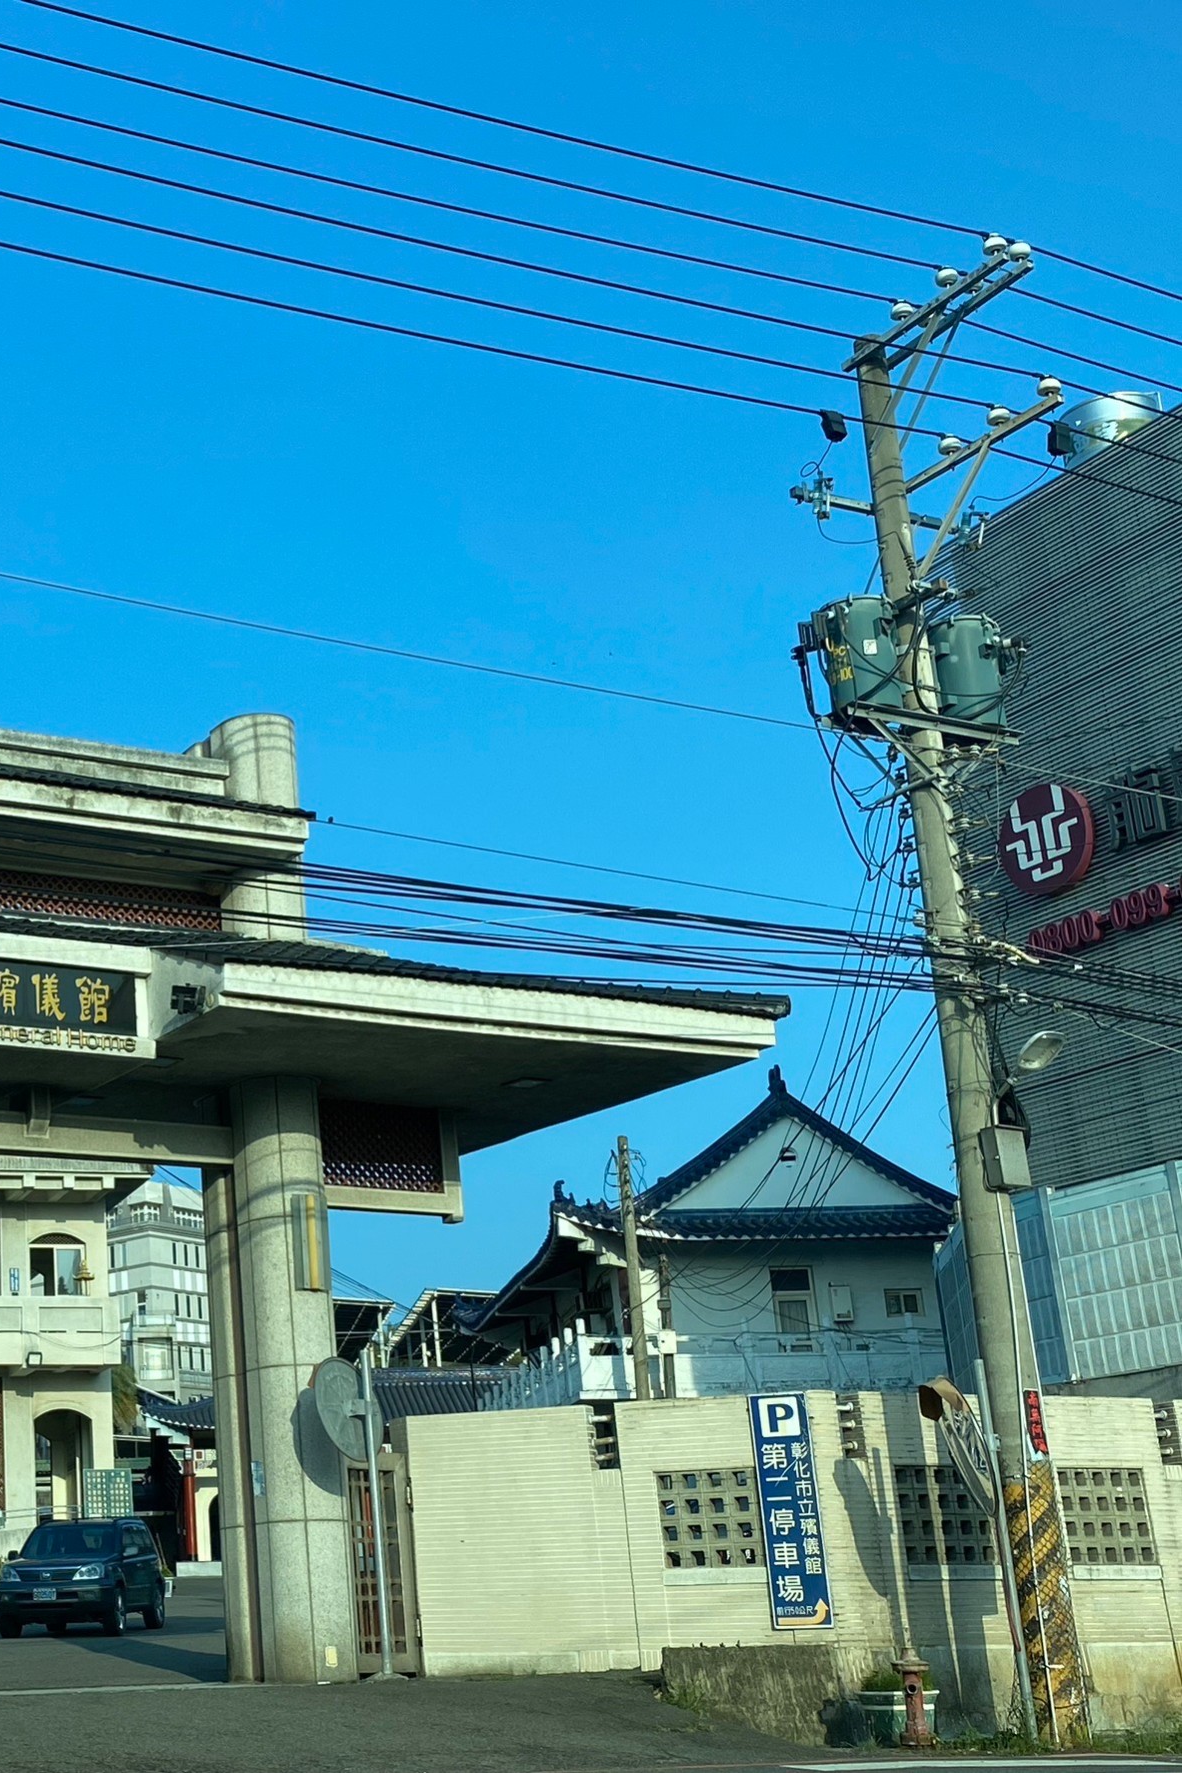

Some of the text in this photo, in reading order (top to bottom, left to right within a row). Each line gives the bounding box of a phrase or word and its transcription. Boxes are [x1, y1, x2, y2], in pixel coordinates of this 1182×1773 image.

[67, 1028, 137, 1053] Home
[767, 1403, 794, 1433] P
[761, 1443, 804, 1602] 第二停車場
[791, 1441, 822, 1574] 彰化市立殯儀館
